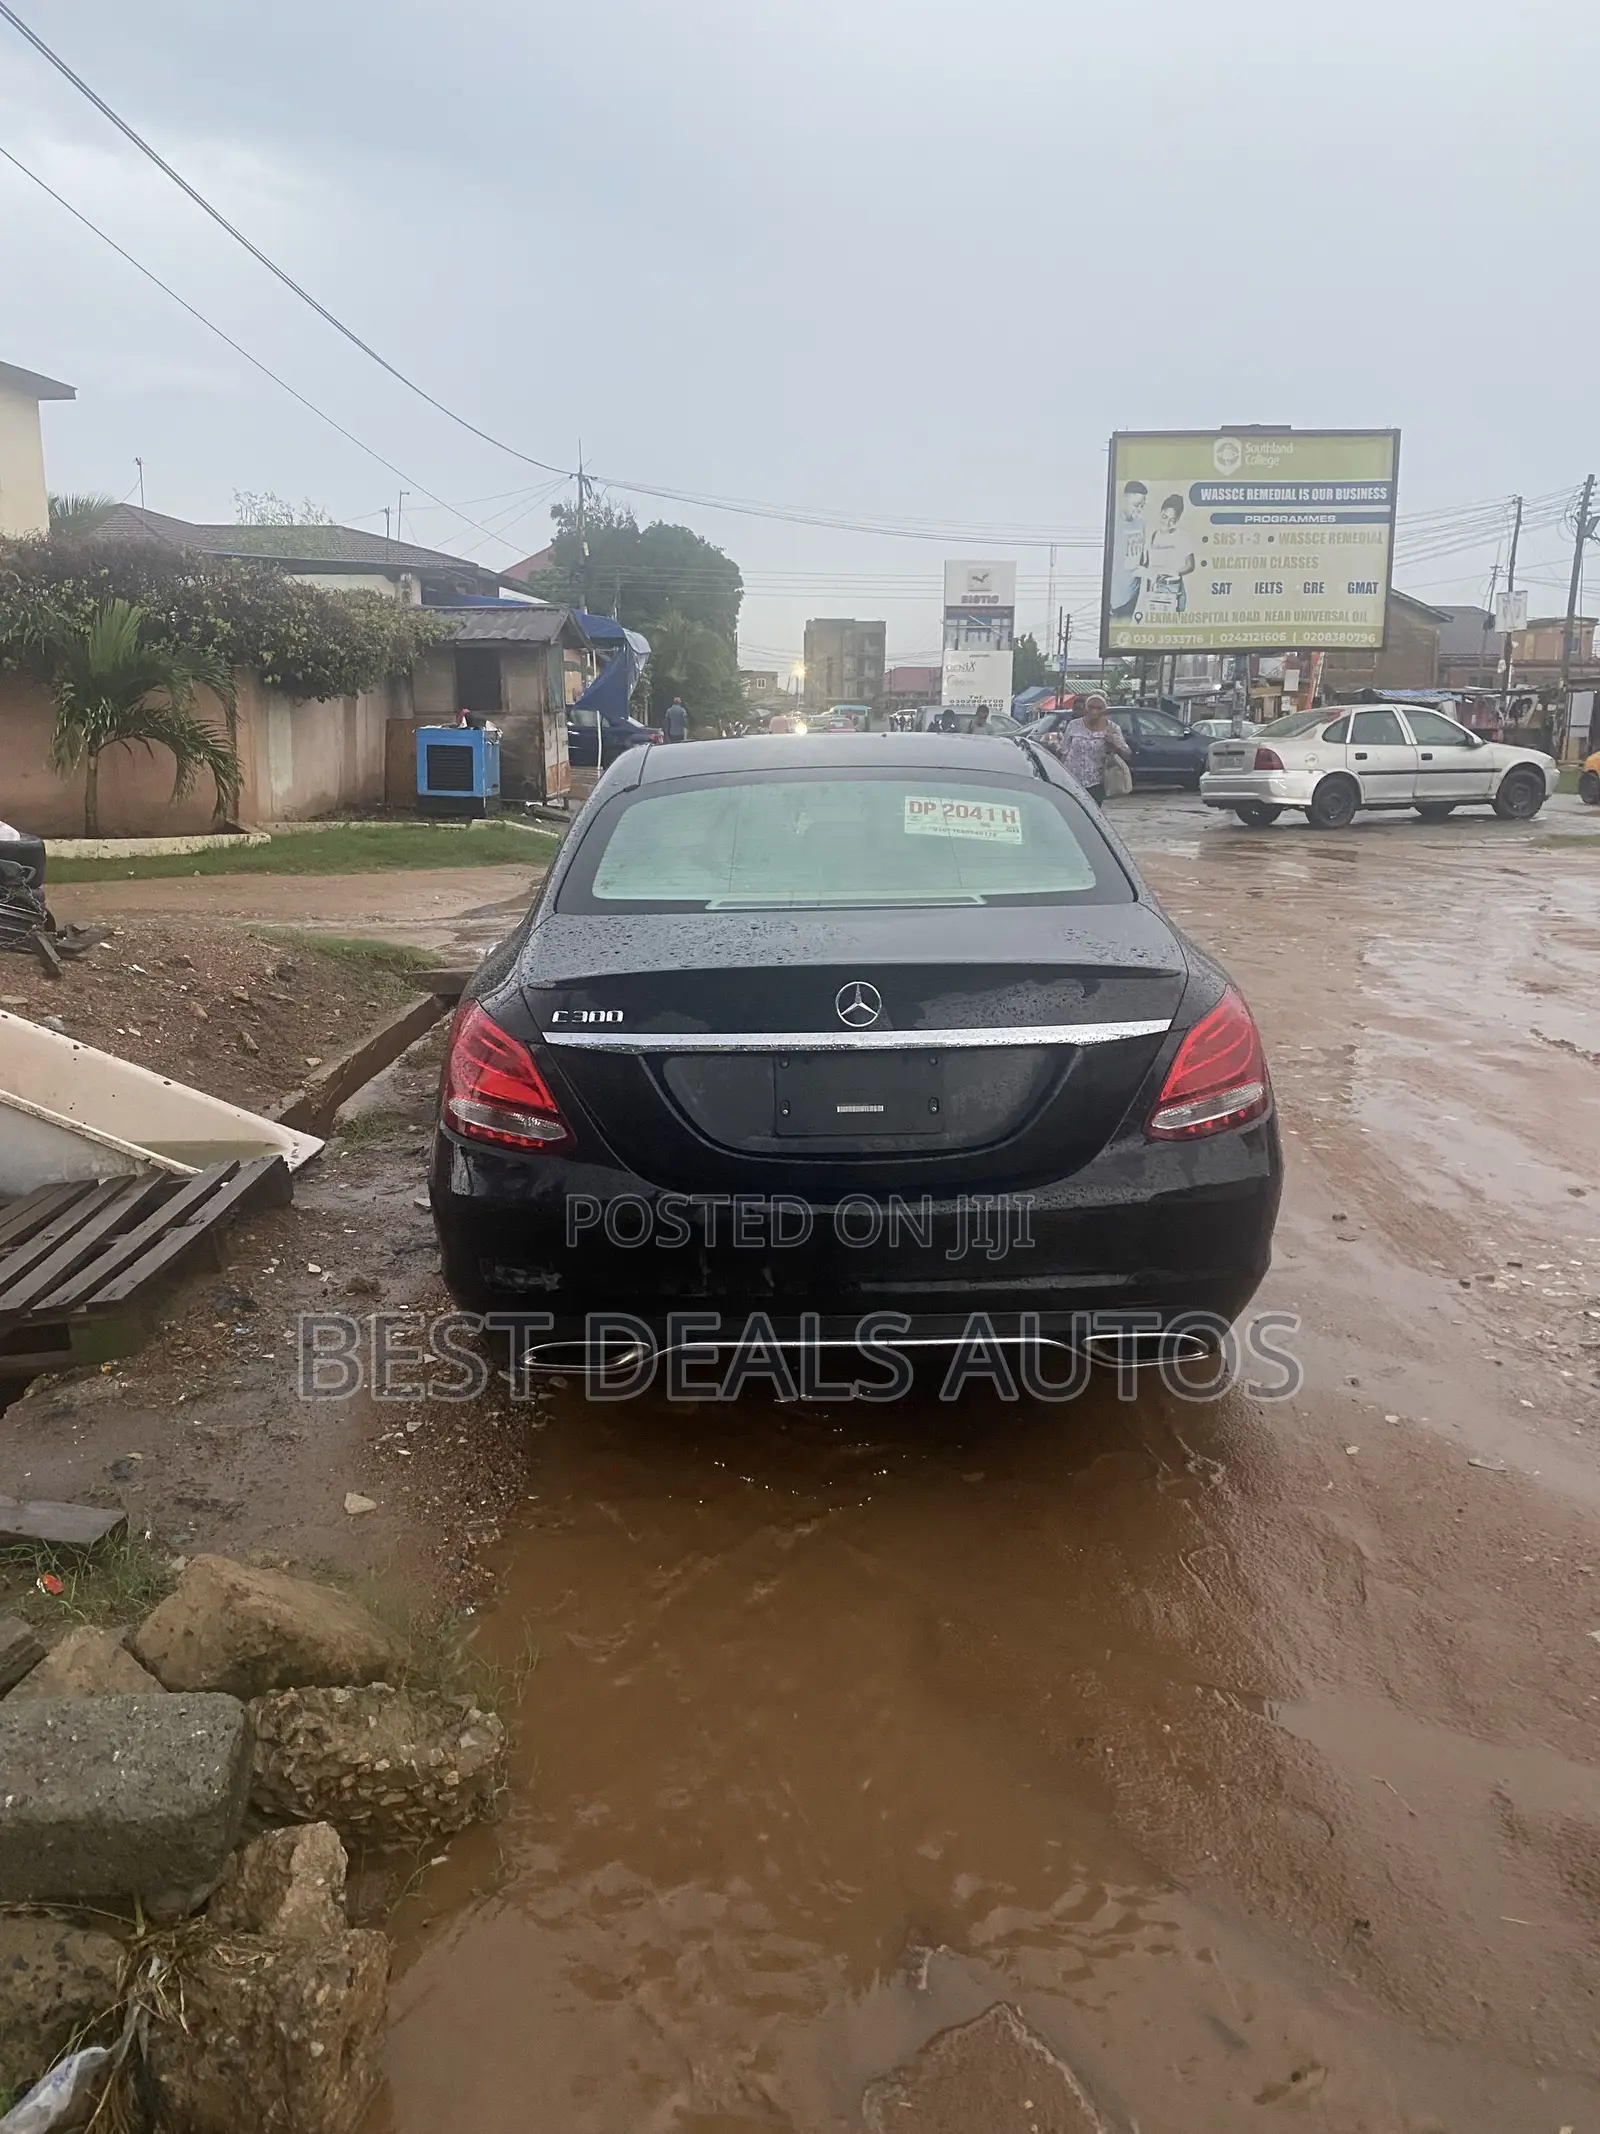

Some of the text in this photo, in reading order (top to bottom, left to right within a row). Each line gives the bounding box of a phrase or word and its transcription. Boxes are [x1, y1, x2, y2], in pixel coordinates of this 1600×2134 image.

[1245, 442, 1294, 453] Southland
[1245, 455, 1280, 468] College
[1201, 487, 1388, 500] WASSCE REMEDIAL IS OUR BUSINESS
[1244, 515, 1336, 523] PROGRAMMES
[1213, 532, 1236, 546] SHS
[1278, 531, 1383, 546] WASSCE REMEDIAL
[1212, 556, 1319, 570] VACATION CLASSES
[1211, 582, 1233, 595] SAT
[1254, 581, 1283, 594] IELTS
[1303, 581, 1325, 594] GRE
[1347, 581, 1379, 595] GMAT
[1180, 611, 1230, 624] HOSPITAL
[1264, 610, 1291, 622] NEAR
[1293, 610, 1350, 622] UNIVERSAL
[1351, 611, 1368, 622] OIL
[1133, 633, 1155, 644] 030
[1303, 631, 1376, 643] 0208380796
[909, 800, 1017, 824] DP 2041 H
[571, 1010, 624, 1023] 300
